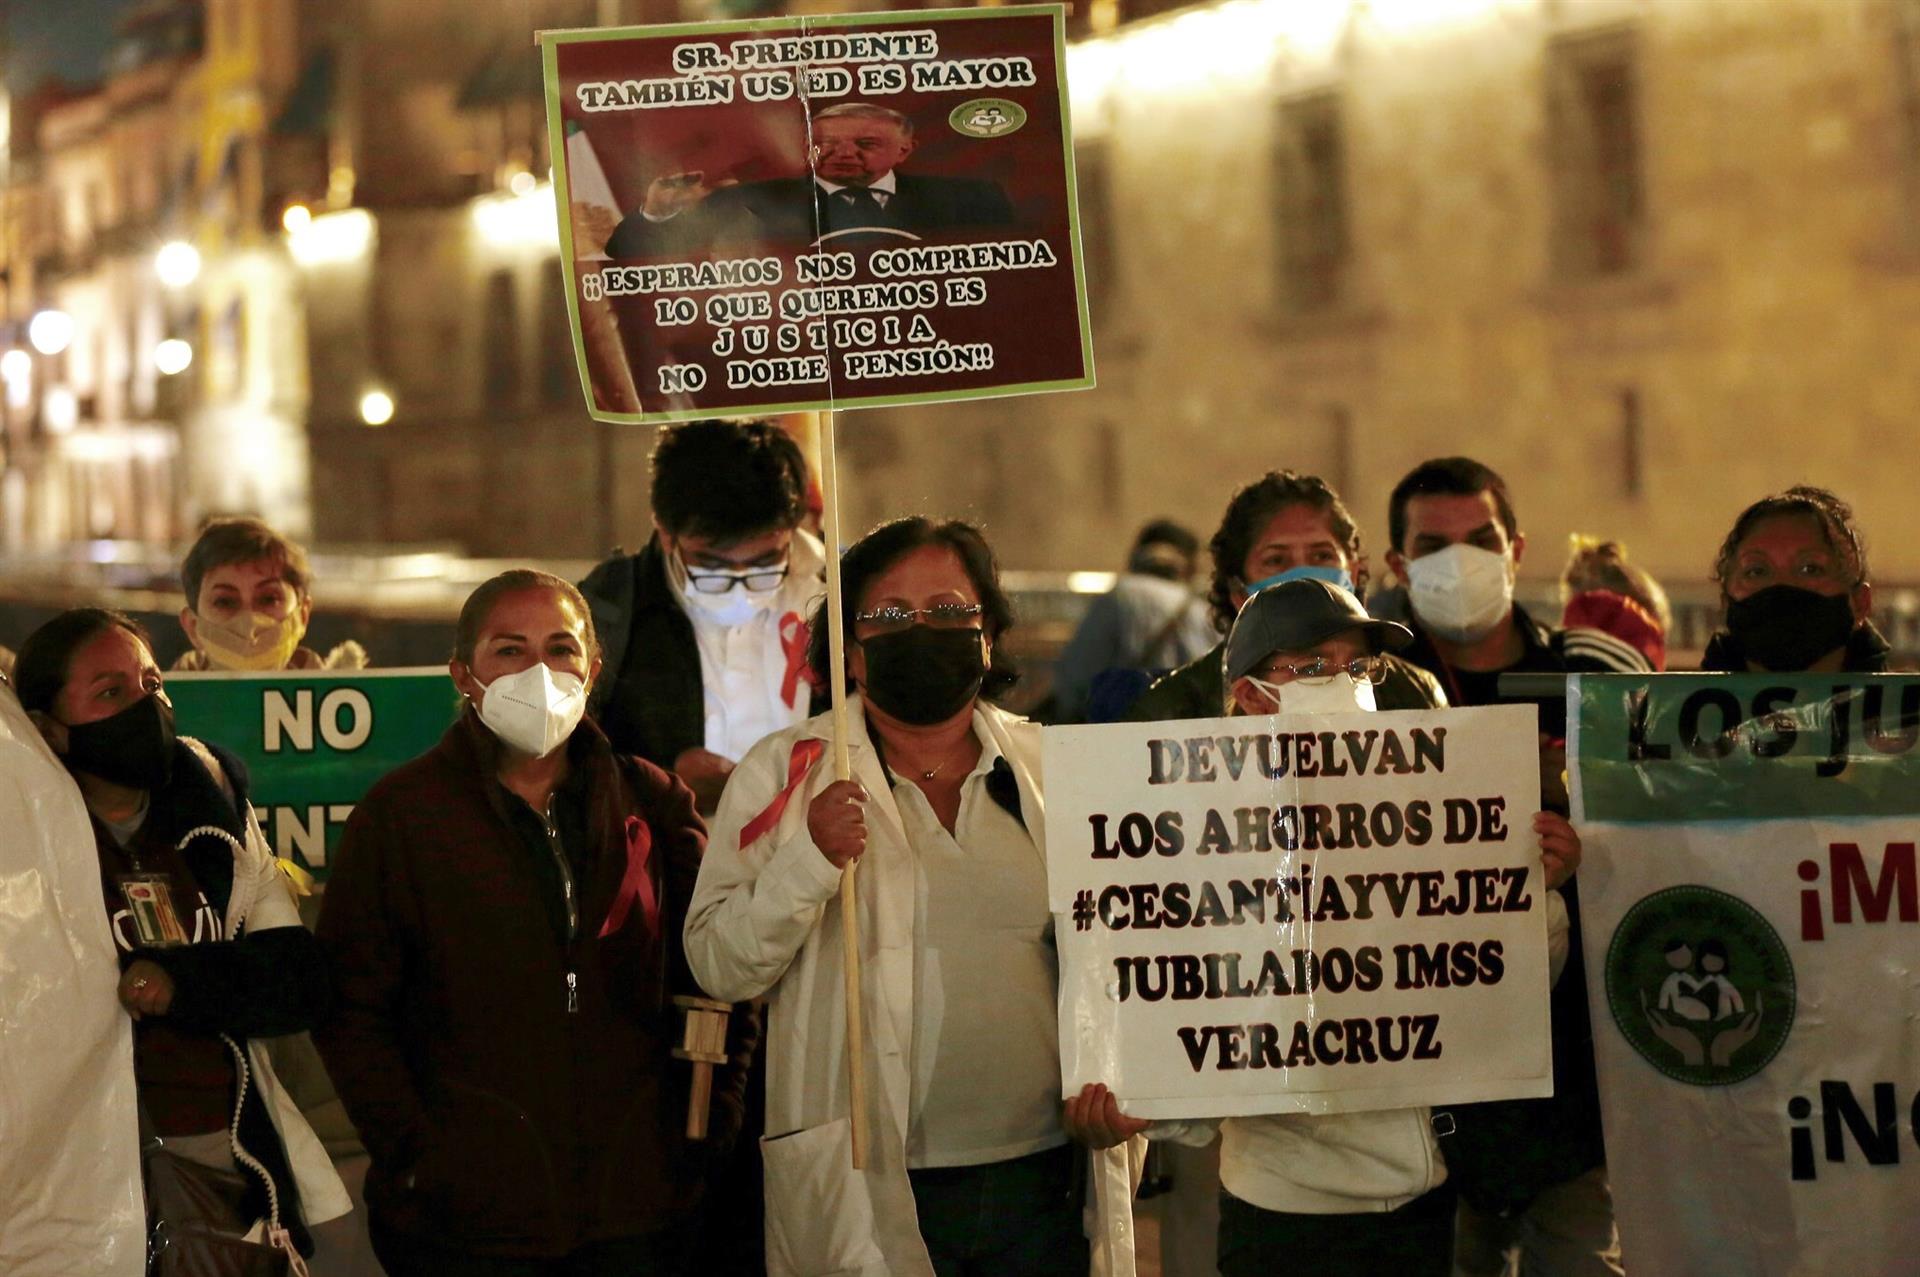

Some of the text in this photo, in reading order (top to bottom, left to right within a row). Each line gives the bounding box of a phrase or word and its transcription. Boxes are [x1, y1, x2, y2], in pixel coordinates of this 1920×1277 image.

[676, 33, 935, 70] SR. PRESIDENTE
[581, 61, 1032, 108] TAMBIÉN USED ES MAYOR
[799, 256, 853, 279] NOS
[872, 242, 1055, 274] COMPRENDA
[657, 280, 984, 324] LO QUE QUEREMOS ES
[662, 343, 991, 390] NO DOBLE PENSIÓN!!
[262, 687, 373, 752] NO
[1626, 684, 1799, 762] LOS
[1147, 728, 1447, 785] DEVUELVAN
[1089, 796, 1508, 859] LOS AHORROS DE
[1072, 864, 1532, 932] #CESANTÍAYVEJEZ
[1108, 939, 1505, 1003] JUBILADOS IMSS
[1177, 1014, 1443, 1073] VERACRUZ
[1788, 1080, 1920, 1181] ¡N
